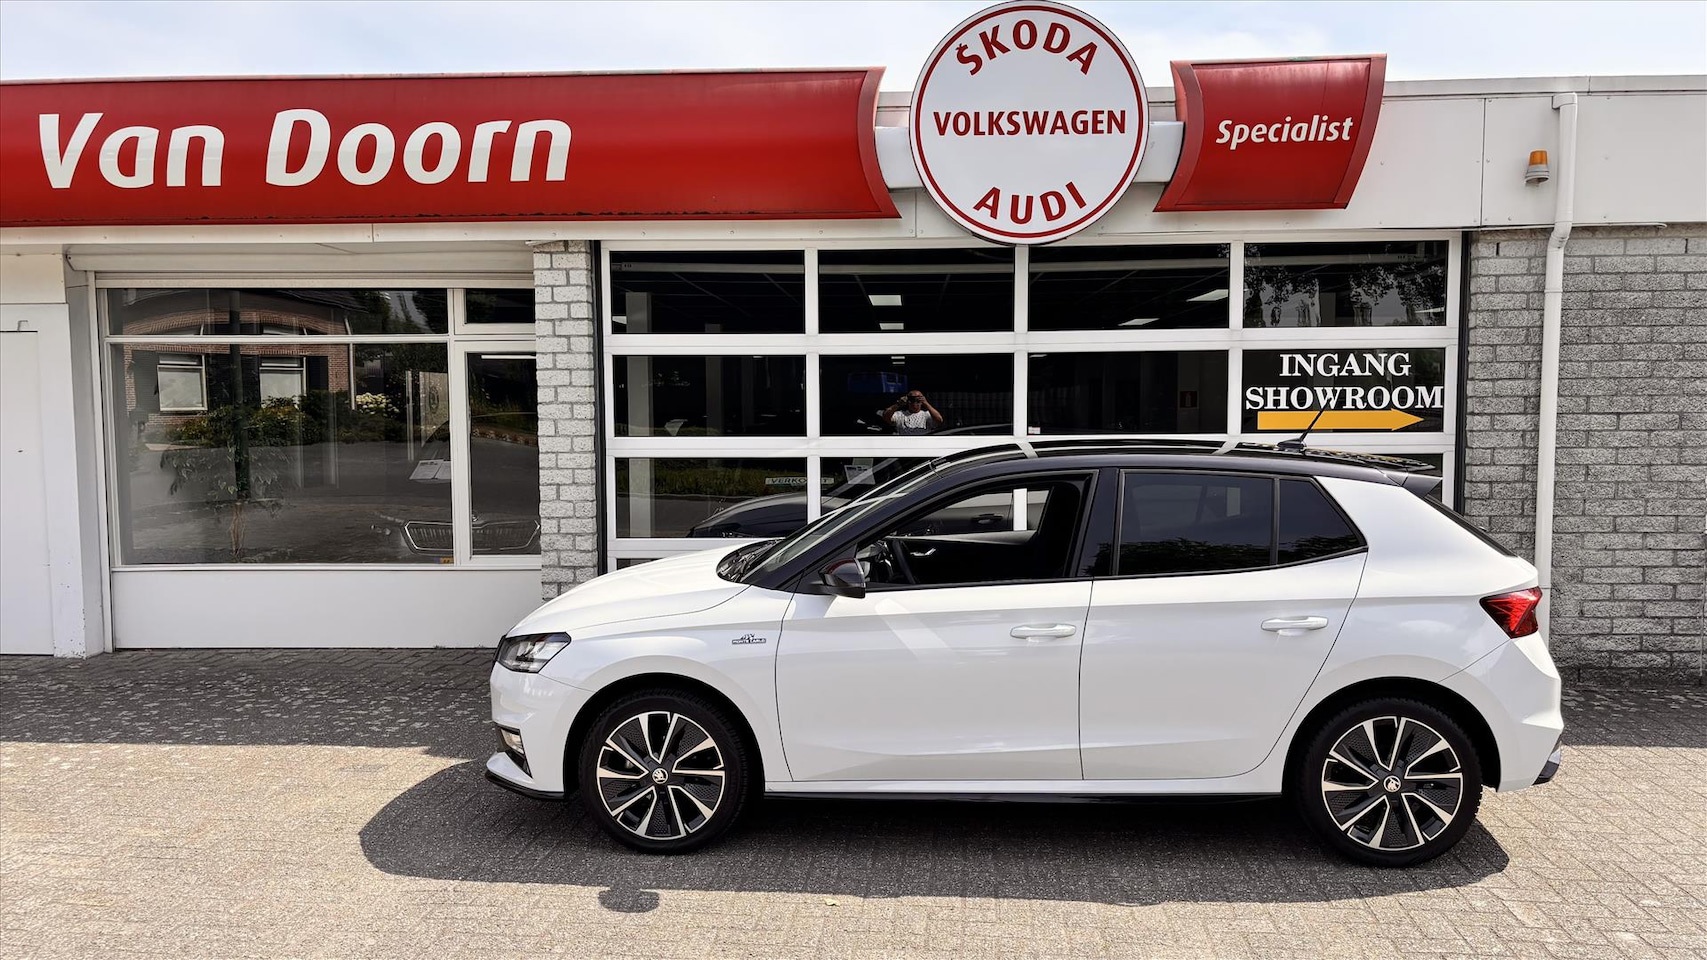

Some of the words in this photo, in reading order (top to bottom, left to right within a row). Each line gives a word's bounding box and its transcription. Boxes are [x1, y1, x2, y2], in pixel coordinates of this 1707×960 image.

[956, 19, 1099, 76] ŠKODA
[934, 110, 1126, 136] VOLKSWAGEN
[1215, 113, 1354, 151] Specialist
[38, 112, 225, 189] Van
[265, 108, 572, 187] Doorn
[973, 181, 1087, 225] AUDI
[1279, 352, 1412, 377] INGANG
[1245, 386, 1444, 410] SHOWROOM
[771, 477, 828, 485] VERKOT
